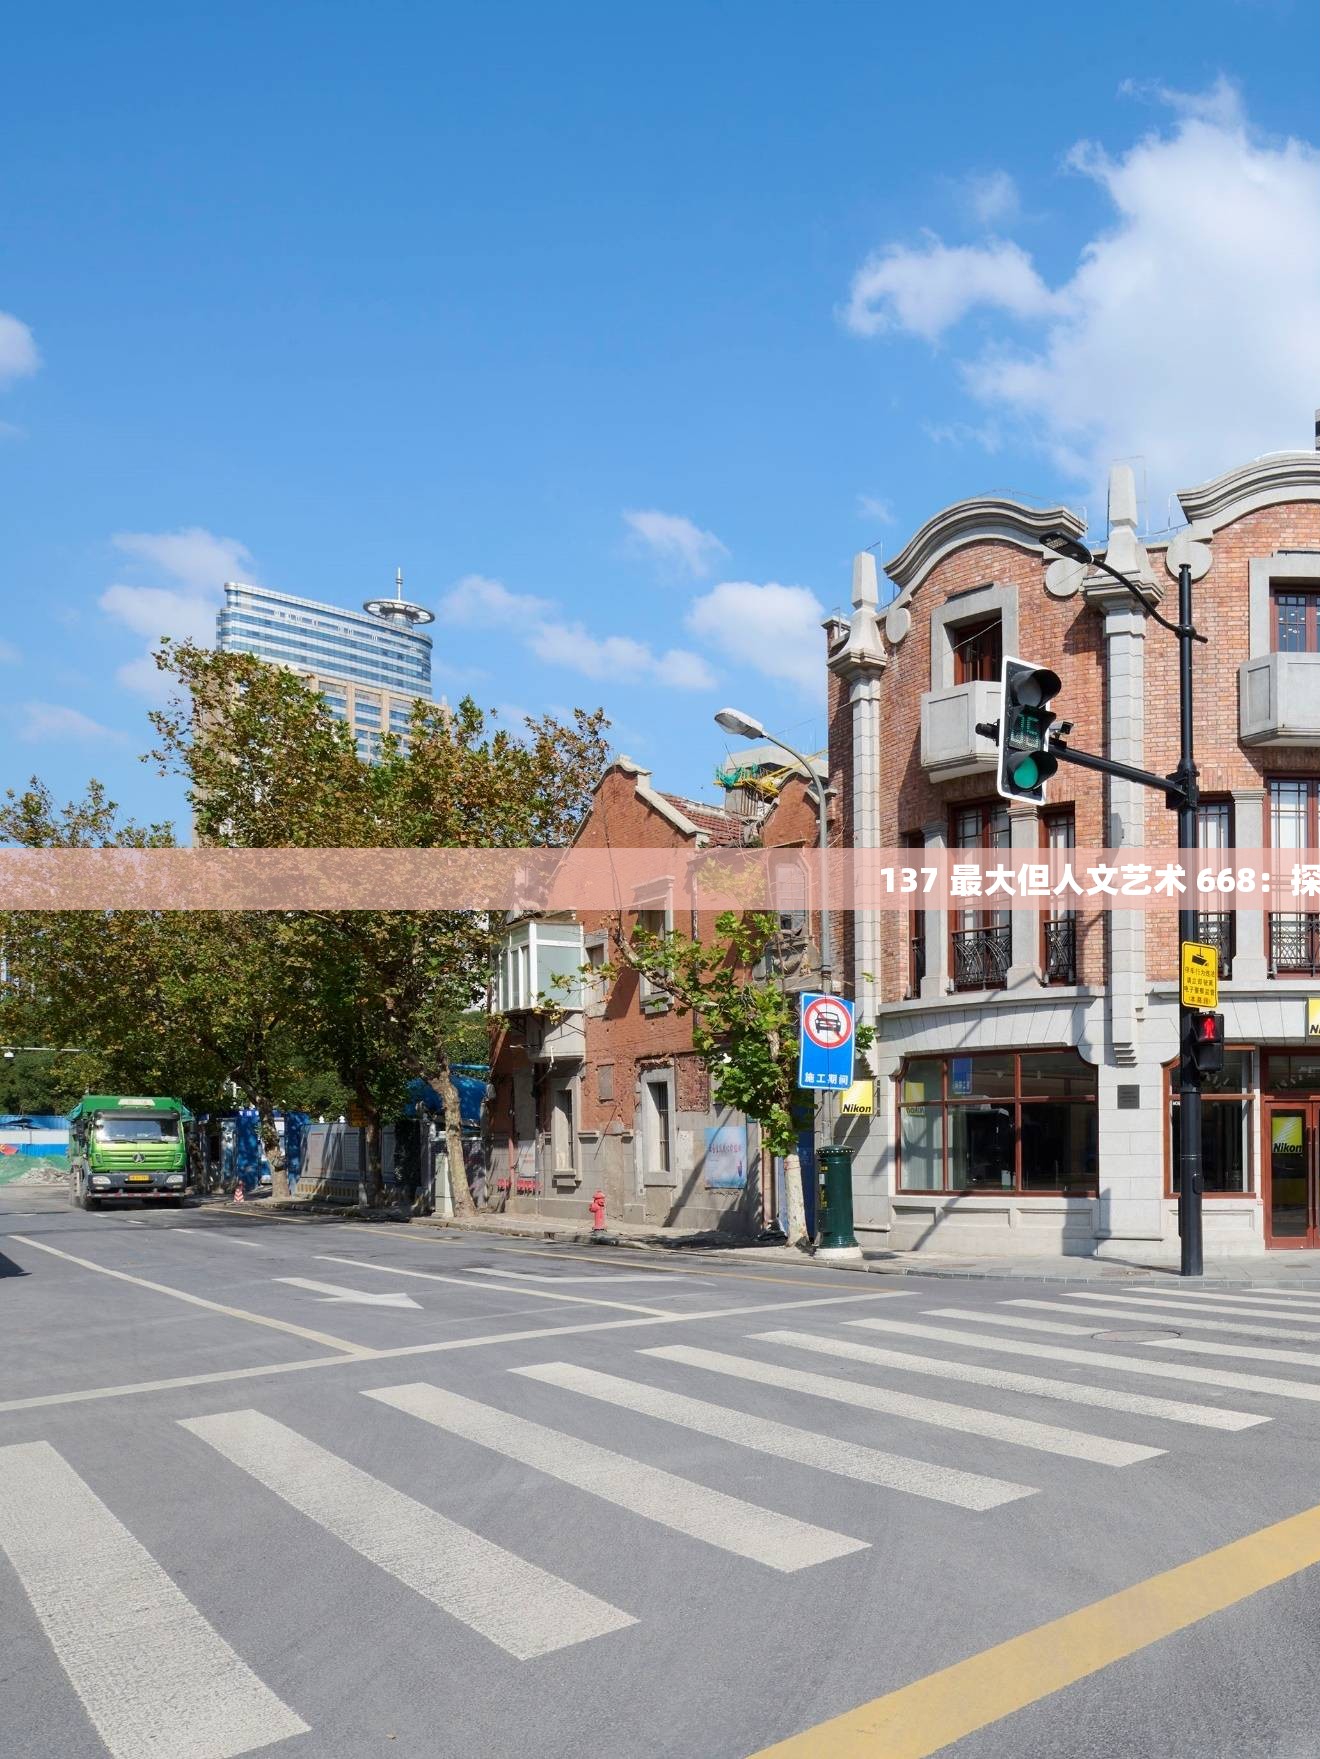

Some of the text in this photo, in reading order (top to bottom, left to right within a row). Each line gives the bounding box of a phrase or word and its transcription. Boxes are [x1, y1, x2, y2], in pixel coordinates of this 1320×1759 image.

[804, 1072, 849, 1086] 施工期间
[843, 1104, 871, 1113] Nikon
[1273, 1142, 1303, 1153] Nikon
